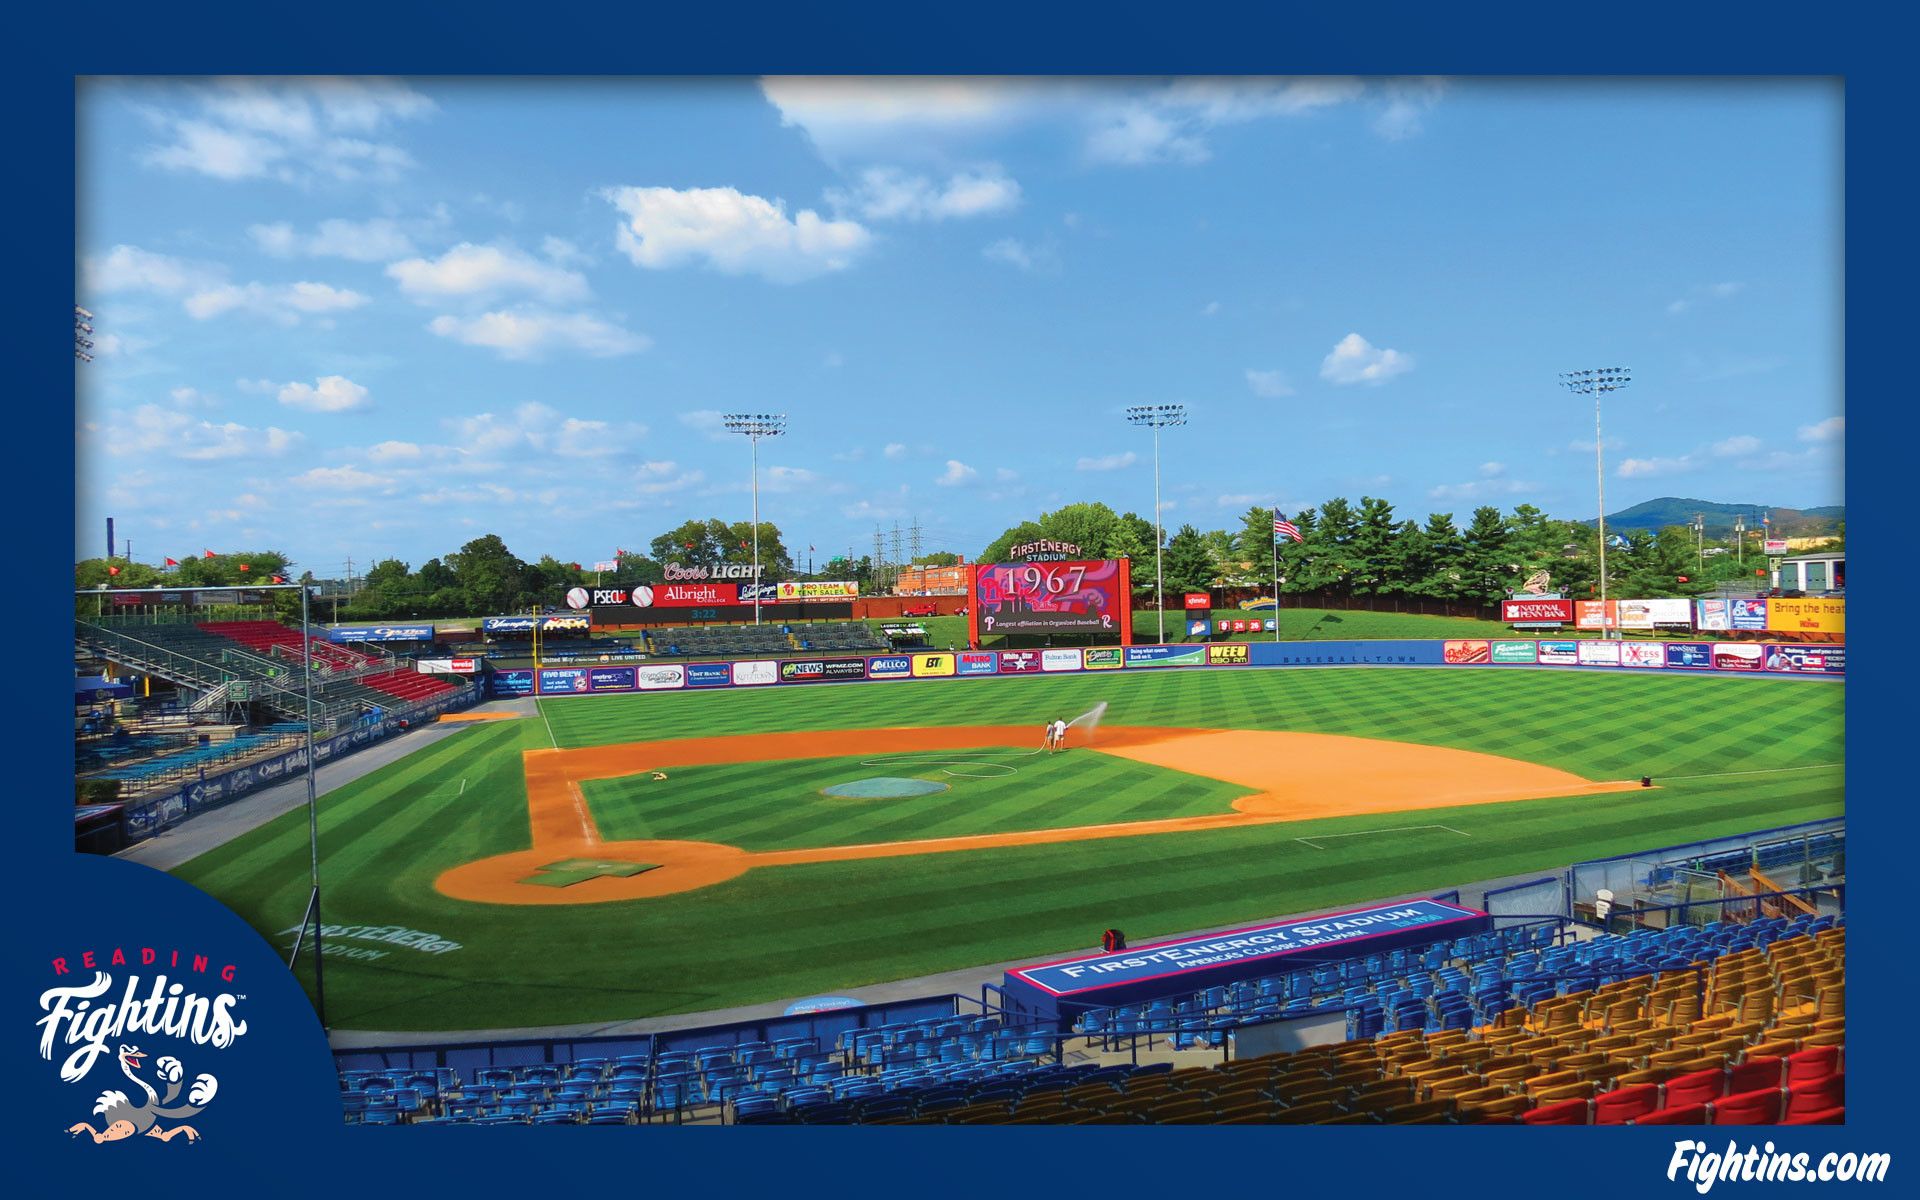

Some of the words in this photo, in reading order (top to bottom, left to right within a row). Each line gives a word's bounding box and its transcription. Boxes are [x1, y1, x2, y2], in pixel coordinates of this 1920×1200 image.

[1010, 538, 1083, 560] FIRSTENERGY
[1026, 552, 1067, 562] STADIUM
[663, 561, 709, 581] Coors
[711, 563, 766, 579] LIGHT
[1005, 565, 1087, 595] 1967
[664, 585, 717, 604] Albright
[797, 589, 817, 597] TENT
[819, 588, 844, 596] SALES
[691, 608, 718, 619] 3:22
[1520, 604, 1559, 612] NATIONAL
[1774, 602, 1800, 616] Bring
[1803, 602, 1820, 614] the
[1544, 610, 1567, 618] BANK
[995, 621, 1017, 629] Longest
[1017, 619, 1042, 628] affiliation
[1049, 619, 1076, 628] Organized
[1077, 618, 1099, 626] Baseball
[1209, 645, 1247, 657] WEEU
[1624, 646, 1660, 662] AXCESS
[962, 653, 991, 664] METRO
[1283, 655, 1416, 664] BASEBALLTOWN
[452, 660, 472, 669] weis
[782, 663, 796, 675] 69
[796, 662, 823, 674] NEWS
[825, 662, 864, 670] WFMZ.COM
[877, 661, 908, 669] BELLCO
[971, 662, 992, 670] BANK
[825, 667, 853, 675] ALWAYS
[1060, 930, 1290, 978] FIRSTENERGY
[1291, 908, 1424, 938] STADIUM
[1246, 941, 1301, 957] CLASSIC
[1301, 928, 1370, 948] BALLPARK
